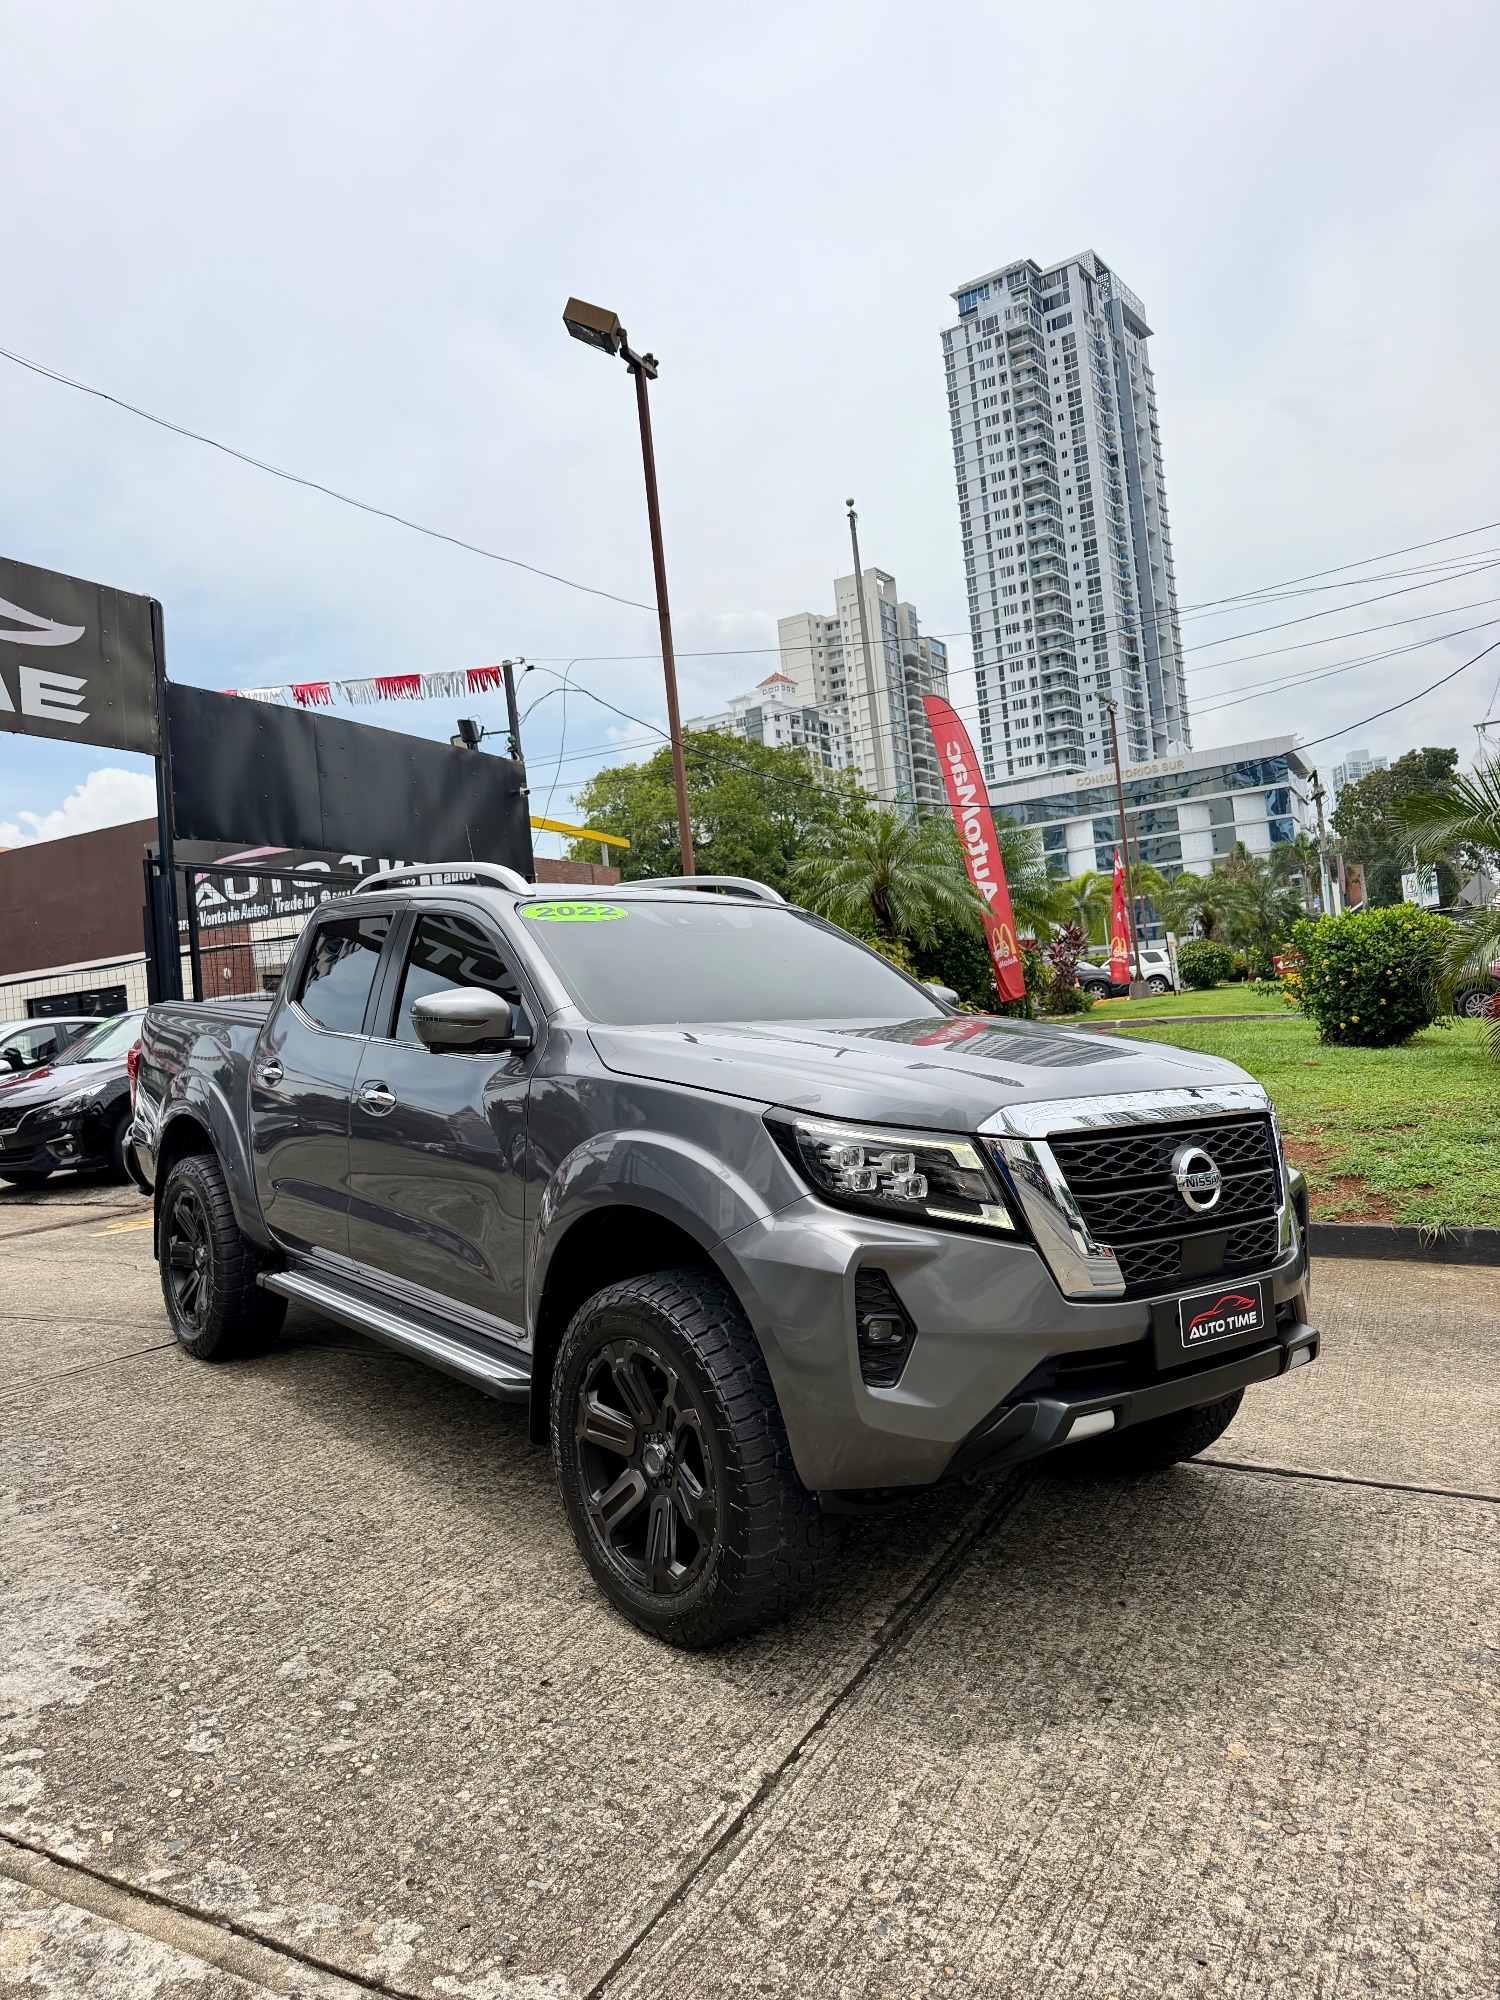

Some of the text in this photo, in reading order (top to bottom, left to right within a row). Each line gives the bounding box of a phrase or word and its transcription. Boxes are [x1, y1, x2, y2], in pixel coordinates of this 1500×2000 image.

[1161, 760, 1185, 772] SUR
[200, 910, 226, 927] Venta
[241, 902, 268, 919] Autos
[274, 893, 303, 914] Trade
[304, 891, 315, 909] in
[536, 906, 619, 918] 2022
[1186, 1174, 1220, 1188] NISSAN
[1189, 1311, 1257, 1340] AUTO TIME
